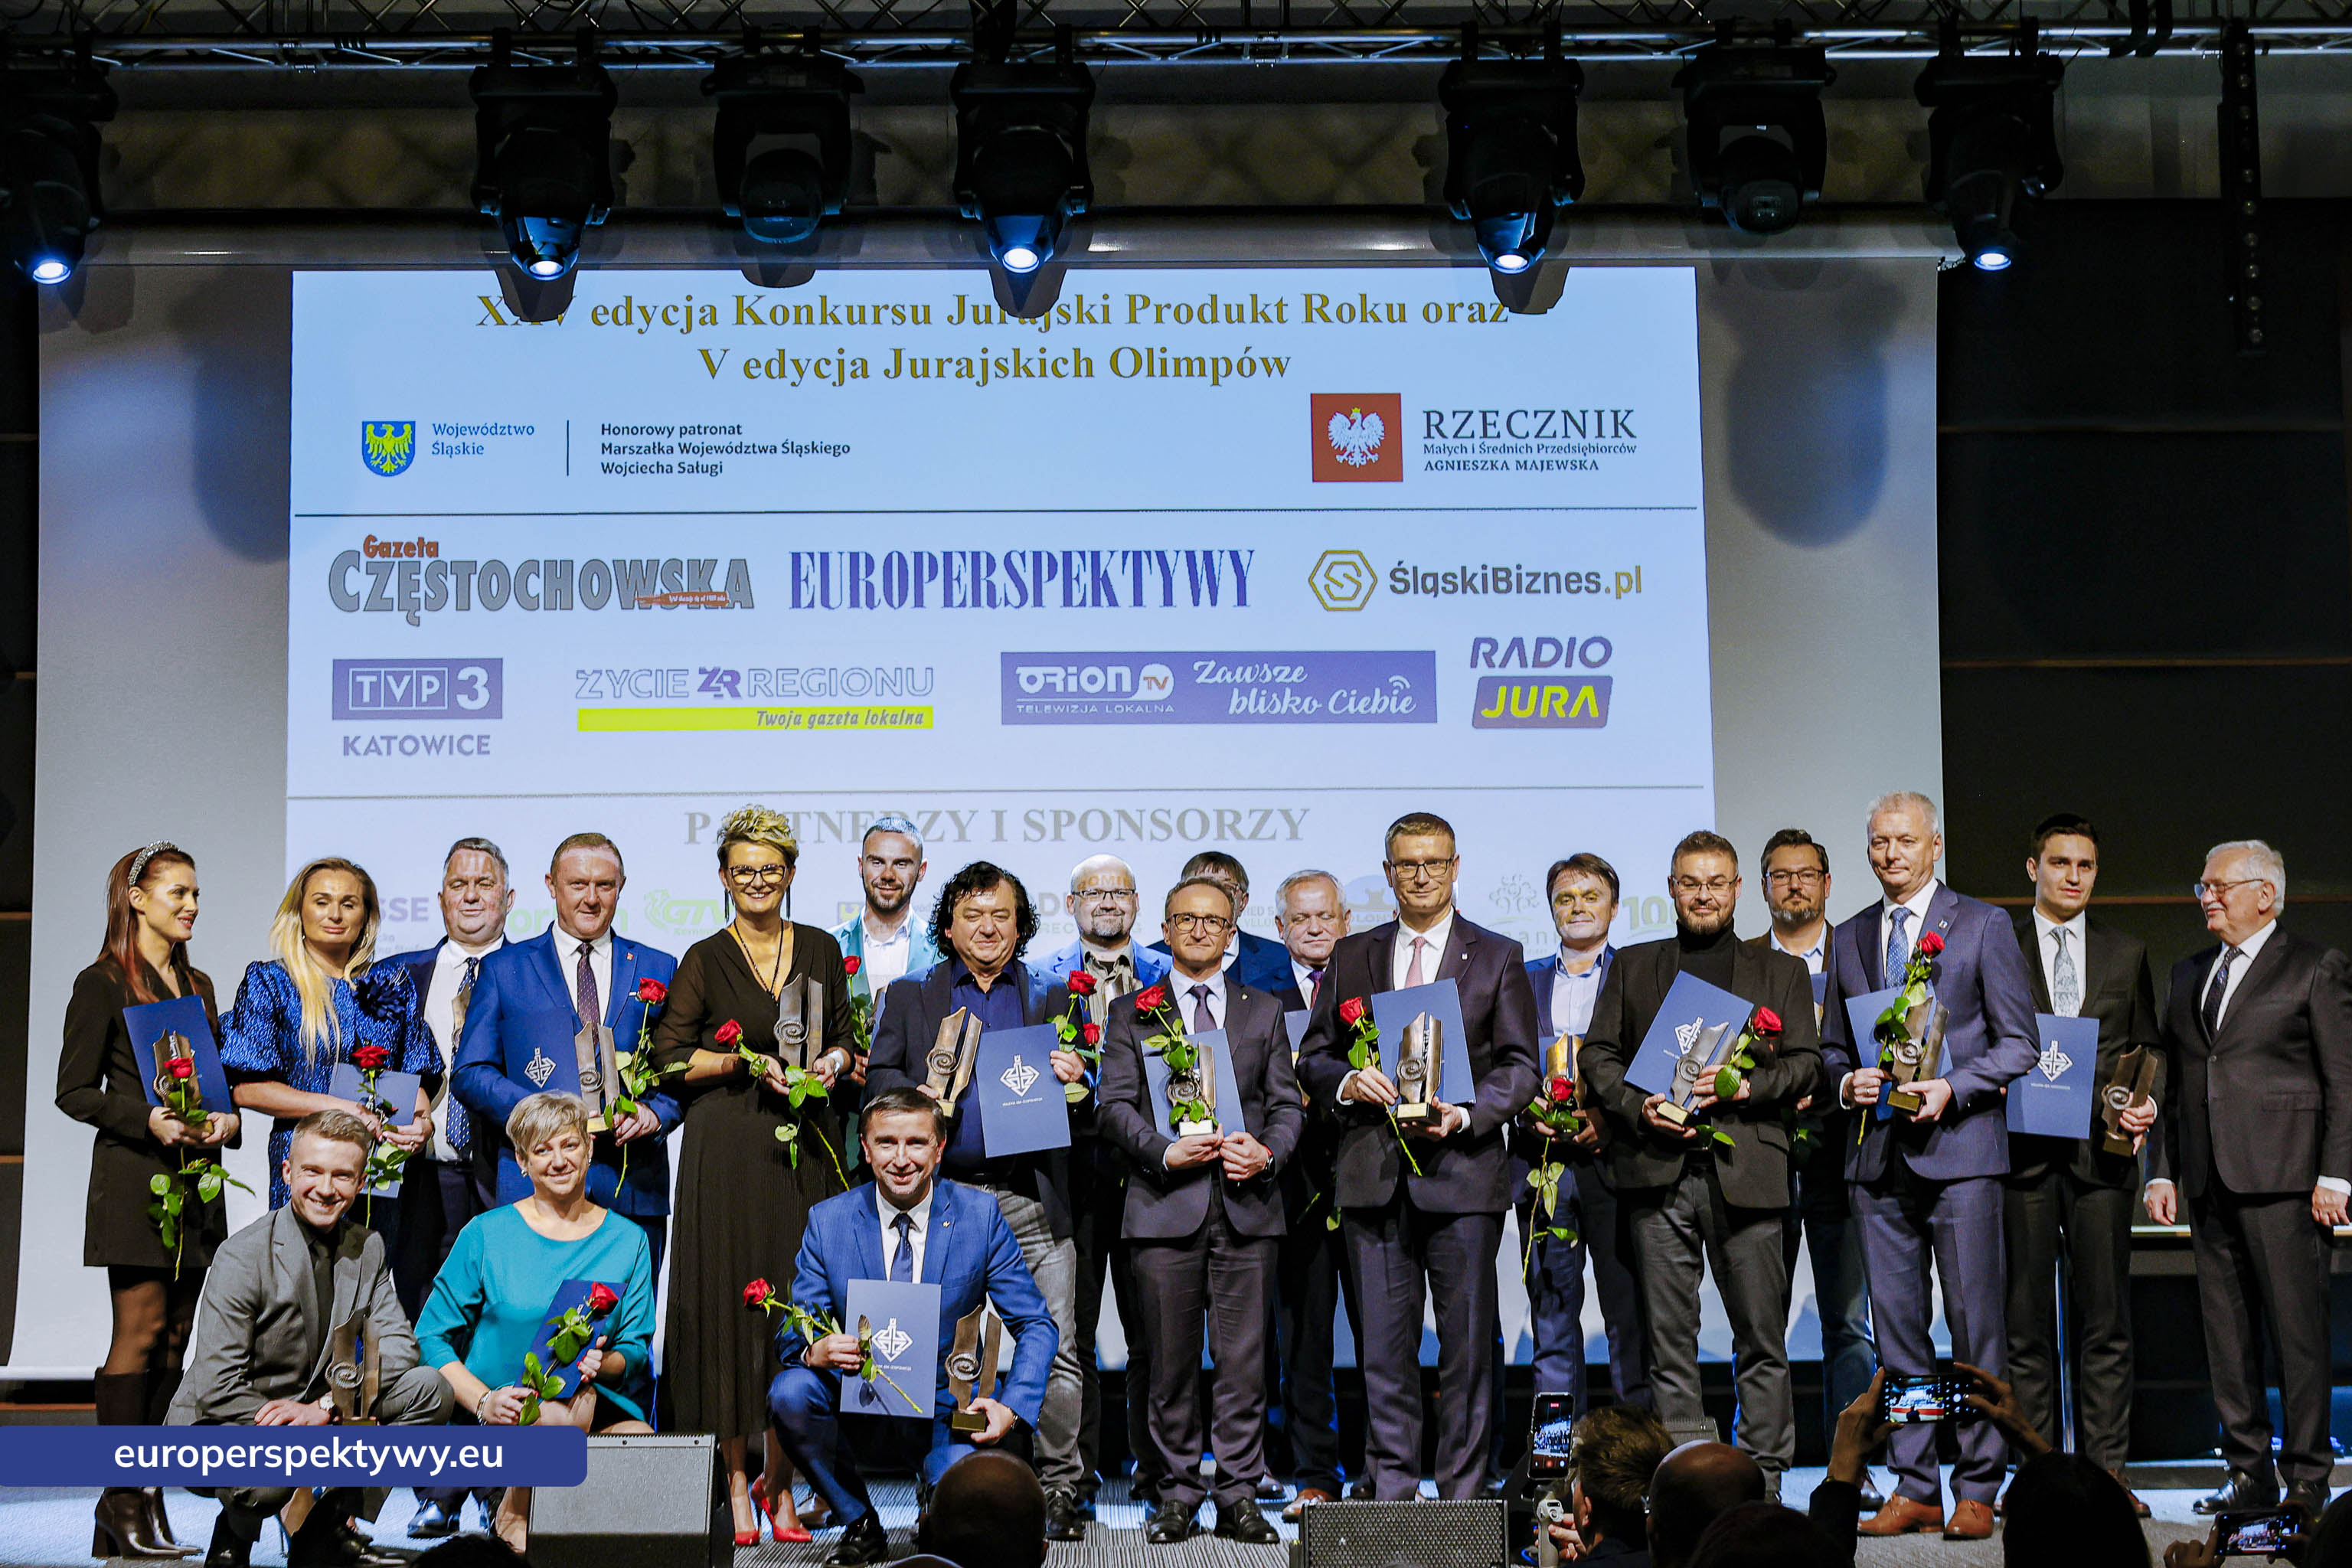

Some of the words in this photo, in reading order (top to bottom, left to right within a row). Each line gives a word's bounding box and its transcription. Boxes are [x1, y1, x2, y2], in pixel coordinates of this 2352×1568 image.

[591, 295, 718, 335] edycja
[735, 295, 931, 326] Konkursu
[1128, 293, 1289, 325] Produkt
[1304, 293, 1406, 324] Roku
[1421, 298, 1511, 326] oraz
[698, 348, 729, 378] V
[743, 348, 870, 387] edycja
[884, 346, 1093, 387] Jurajskich
[1109, 345, 1290, 387] Olimpów
[432, 422, 535, 439] Województwo
[601, 423, 675, 443] Honorowy
[679, 423, 743, 443] patronat
[1423, 409, 1637, 440] RZECZNIK
[431, 440, 485, 459] Śląskie
[601, 441, 675, 456] Marszałka
[678, 441, 777, 458] Województwa
[781, 439, 851, 458] Śląskiego
[1423, 443, 1468, 457] Małych
[1472, 443, 1475, 454] i
[1478, 438, 1533, 455] Średnich
[1537, 443, 1637, 457] Przedsiębiorców
[600, 461, 674, 478] Wojciecha
[678, 460, 723, 478] Saługi
[1424, 459, 1510, 472] AGNIESZKA
[1515, 459, 1599, 472] MAJEWSKA
[363, 534, 439, 559] Gazeta
[328, 550, 755, 627] CZĘSTOCHOWSKA
[791, 549, 1255, 611] EUROPERSPEKTYWY
[1389, 560, 1642, 599] ŚląskiBiznes.pl
[1469, 635, 1613, 669] RADIO
[747, 667, 934, 699] REGIONU
[1192, 660, 1308, 684] Zawsze
[1016, 703, 1099, 714] TELEWIZJA
[1105, 703, 1177, 715] LOKALNA
[1228, 682, 1324, 715] blisko
[1328, 684, 1417, 715] Ciebie
[1480, 684, 1601, 718] JURA
[756, 710, 803, 731] Twoja
[805, 710, 861, 731] gazeta
[863, 705, 924, 727] lokalna
[342, 734, 491, 757] KATOWICE
[991, 808, 1008, 843] I
[1023, 808, 1311, 843] SPONSORZY
